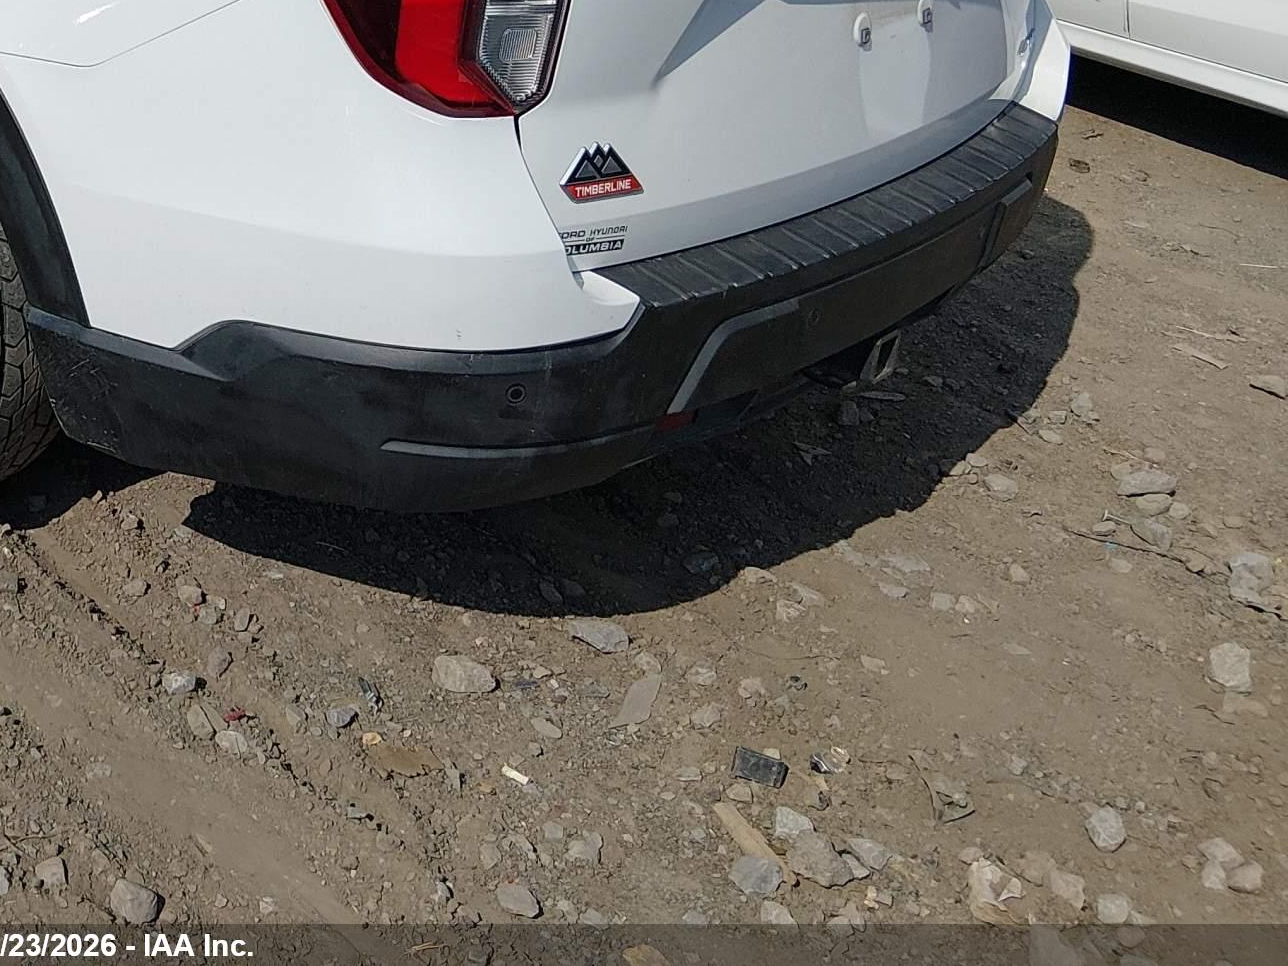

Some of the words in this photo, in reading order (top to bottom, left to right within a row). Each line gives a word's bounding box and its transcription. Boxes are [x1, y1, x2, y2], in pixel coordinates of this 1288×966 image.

[574, 178, 633, 198] TIMBERLINE
[590, 225, 629, 236] HYUNDAI
[565, 240, 622, 254] OLUMBIA
